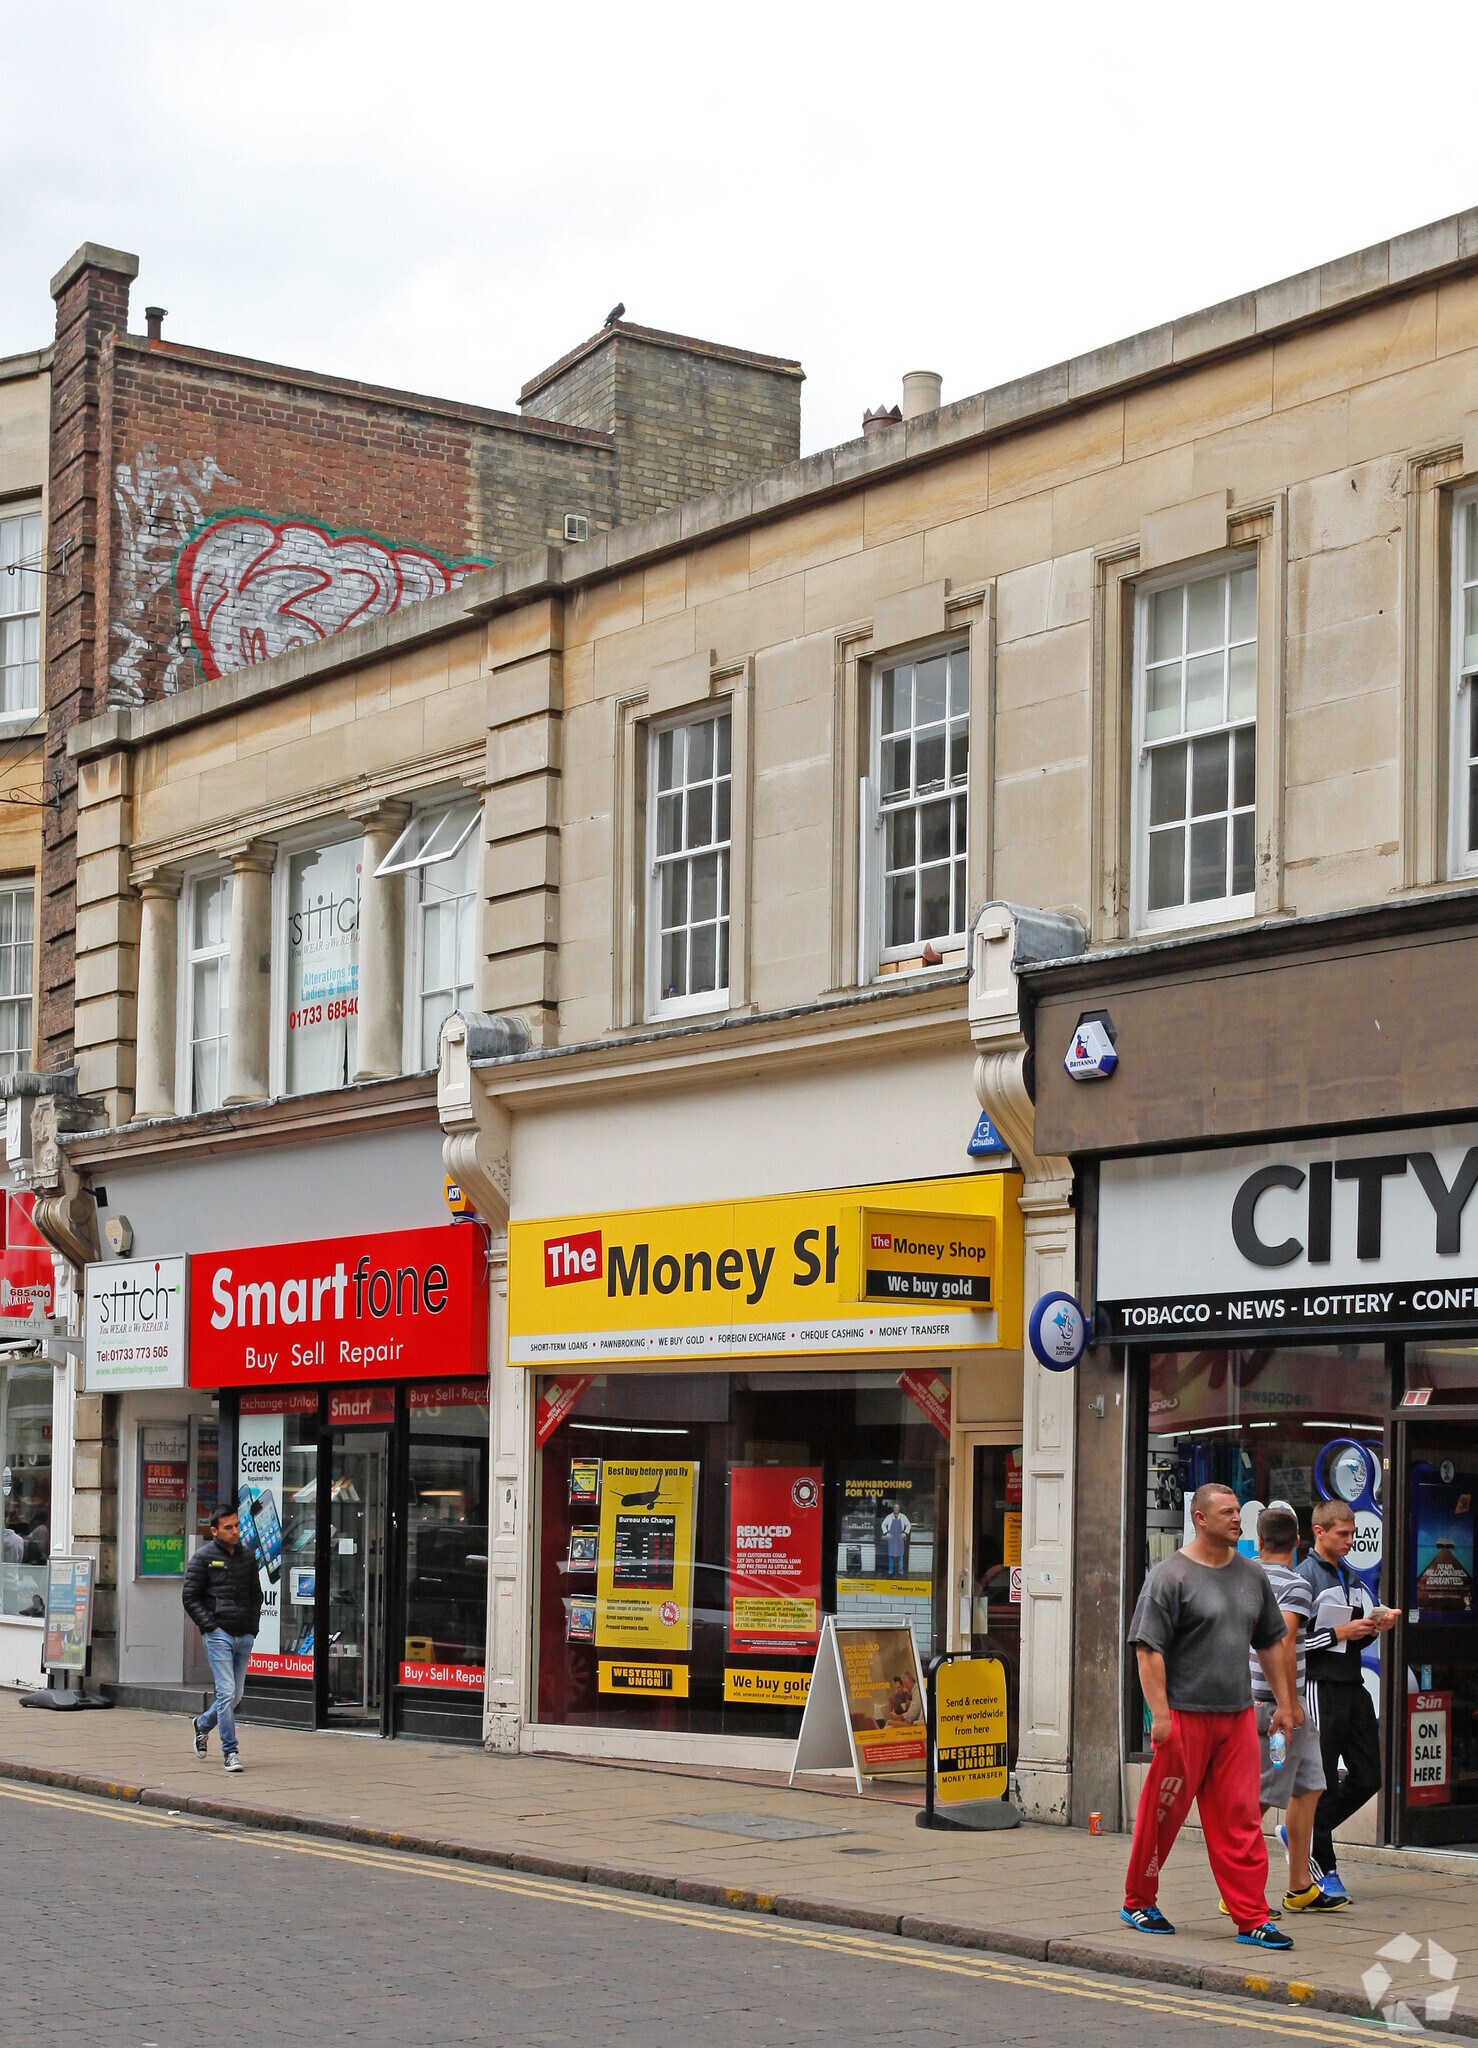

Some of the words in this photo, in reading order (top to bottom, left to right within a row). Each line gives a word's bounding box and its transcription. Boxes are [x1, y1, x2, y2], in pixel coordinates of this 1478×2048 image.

[304, 968, 346, 988] Alterations
[301, 985, 326, 1002] Ladies
[289, 1004, 323, 1031] 01733
[1069, 1059, 1097, 1068] BRITANNIA
[972, 1137, 995, 1147] Chubb
[448, 1187, 460, 1200] ADT
[1231, 1146, 1478, 1267] CITY
[872, 1235, 890, 1248] The
[893, 1238, 945, 1260] Money
[949, 1242, 986, 1262] Shop
[547, 1241, 597, 1279] The
[608, 1243, 775, 1305] Money
[9, 1288, 51, 1299] 685400
[887, 1275, 909, 1293] We
[912, 1276, 938, 1298] buy
[941, 1278, 973, 1298] gold
[1121, 1303, 1211, 1327] TOBACCO
[1228, 1299, 1285, 1321] NEWS
[1303, 1293, 1394, 1316] LOTTERY
[109, 1324, 128, 1334] WEAR
[141, 1321, 164, 1332] REPAIR
[530, 1342, 567, 1352] SHORT-TERM
[568, 1341, 588, 1351] LOANS
[600, 1338, 646, 1348] PAWNBROKING
[658, 1337, 668, 1346] WE
[670, 1336, 684, 1346] BUY
[686, 1335, 705, 1345] GOLD
[718, 1334, 747, 1343] FOREIGN
[749, 1331, 786, 1342] EXCHANGE
[800, 1329, 829, 1340] CHEQUE
[831, 1328, 864, 1339] CASHING
[879, 1326, 908, 1337] MONEY
[911, 1324, 950, 1335] TRANSFER
[136, 1346, 151, 1359] 773
[153, 1345, 168, 1358] 505
[245, 1346, 279, 1374] Buy
[291, 1341, 325, 1367] Sell
[339, 1337, 404, 1369] Repair
[410, 1390, 428, 1404] Buy
[436, 1388, 455, 1401] Sell
[240, 1398, 283, 1410] Exchange
[241, 1440, 281, 1457] Cracked
[148, 1464, 173, 1477] FREE
[241, 1457, 281, 1473] Screens
[607, 1466, 624, 1476] Best
[625, 1467, 639, 1477] buy
[640, 1466, 664, 1476] before
[665, 1467, 678, 1477] you
[679, 1467, 689, 1477] fly
[159, 1477, 185, 1485] CLEANING
[845, 1480, 913, 1489] PAWNBROKING
[845, 1488, 862, 1497] FOR
[864, 1488, 883, 1497] YOU
[651, 1517, 674, 1525] Change
[736, 1525, 792, 1537] REDUCED
[1355, 1527, 1379, 1539] LAY
[145, 1539, 166, 1551] 10%
[166, 1538, 183, 1551] OFF
[736, 1537, 773, 1549] RATES
[1349, 1541, 1379, 1553] NOW
[842, 1644, 857, 1653] YOU
[857, 1643, 880, 1652] COULD
[405, 1667, 423, 1682] Buy
[430, 1667, 449, 1681] Sell
[613, 1668, 661, 1679] WESTERN
[628, 1677, 661, 1687] UNION
[732, 1675, 752, 1688] We
[756, 1675, 780, 1693] buy
[850, 1681, 891, 1691] GUARANTOR
[945, 1697, 963, 1708] Send
[964, 1696, 970, 1706] &
[972, 1695, 999, 1706] receive
[1416, 1695, 1443, 1710] Sun
[940, 1713, 964, 1724] money
[966, 1709, 1004, 1720] worldwide
[954, 1726, 972, 1735] from
[973, 1725, 990, 1734] here
[1418, 1723, 1438, 1739] ON
[939, 1744, 994, 1761] WESTERN
[1415, 1745, 1442, 1761] SALE
[957, 1755, 994, 1770] UNION
[941, 1774, 966, 1784] MONEY
[968, 1770, 1003, 1781] TRANSFER
[1413, 1766, 1442, 1783] HERE
